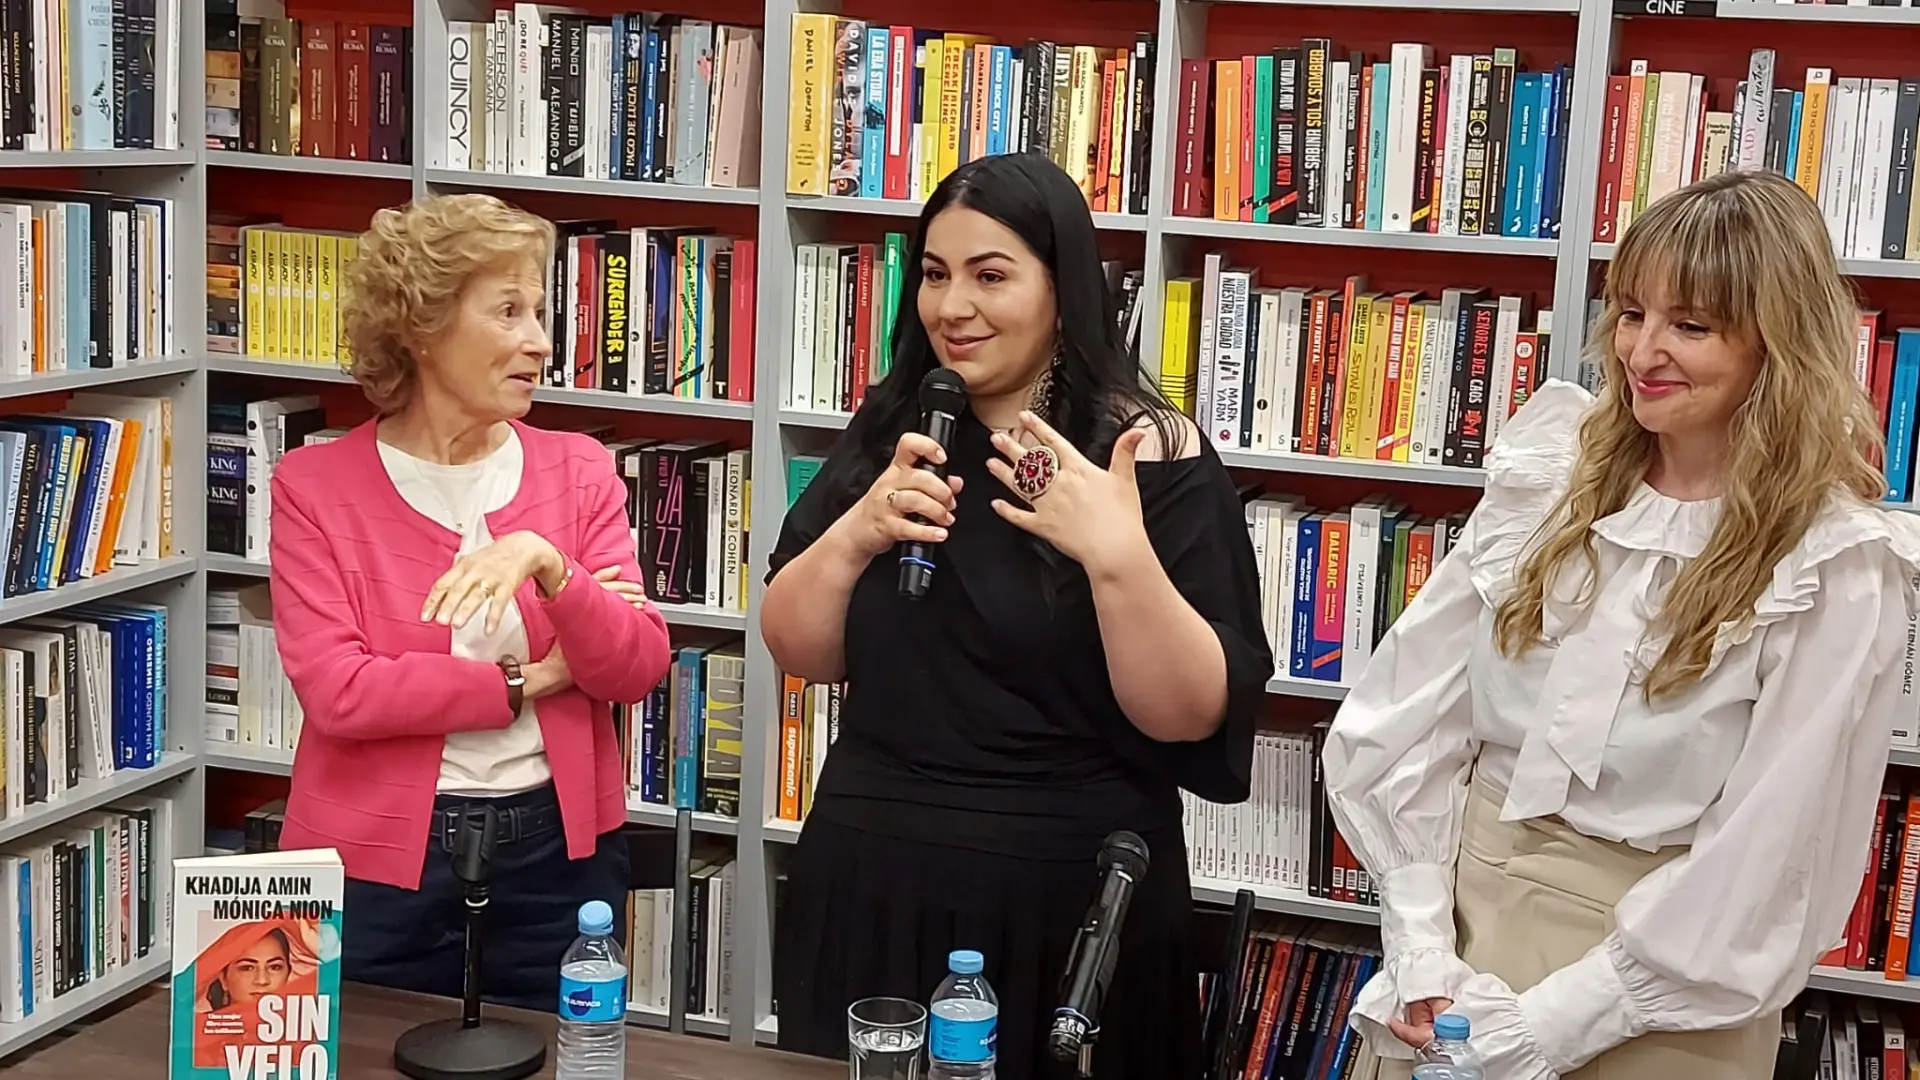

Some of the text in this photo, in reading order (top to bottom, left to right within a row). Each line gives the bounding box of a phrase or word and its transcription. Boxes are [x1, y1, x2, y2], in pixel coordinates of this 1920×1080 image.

[1645, 0, 1685, 15] CINE
[496, 20, 506, 112] PETERSON
[847, 29, 859, 83] DAVID
[943, 47, 952, 88] SCENE
[951, 47, 960, 88] FREAK
[1054, 52, 1070, 88] HEY!
[450, 38, 468, 149] QUINCY
[550, 19, 562, 158] MANUEL ALEJANDRO
[804, 29, 814, 131] DANIEL JOHNSTON
[993, 52, 1004, 133] FARGO ROCK CITY
[1812, 92, 1820, 108] CINE
[626, 86, 637, 166] PACO DE LUCÍA
[949, 95, 958, 150] RICHARD
[1304, 49, 1325, 169] SABINA SOL Y SOMBRA
[1421, 79, 1434, 145] STARLUST
[1630, 92, 1640, 131] MARIPOSAS
[1810, 119, 1817, 127] EN
[1811, 109, 1818, 118] EL
[832, 118, 842, 172] JONES
[1628, 132, 1635, 141] DE
[1743, 126, 1755, 160] LADY
[1806, 129, 1815, 163] CREACIÓN
[1626, 142, 1635, 177] CAZADOR
[1805, 164, 1812, 173] DE
[606, 254, 627, 353] SURRENDER
[1219, 277, 1234, 349] NUESTRA CIUDAD
[1457, 309, 1469, 348] SINATRA
[1455, 359, 1463, 372] YO
[1468, 310, 1491, 404] SEÑORES DEL CAOS
[1215, 389, 1226, 421] YARM
[1227, 388, 1238, 423] MARK
[210, 457, 237, 471] KING
[18, 491, 29, 530] ÁRBOL
[26, 443, 37, 470] VIDA
[46, 435, 71, 543] CÓMO DECIDE TU CEREBRO
[163, 464, 172, 534] GENES
[211, 486, 238, 500] KING
[729, 464, 738, 516] LEONARD
[727, 535, 737, 575] COHEN
[1326, 531, 1340, 589] BALEARIC
[1357, 563, 1365, 607] CONTRAPELO
[68, 636, 76, 672] WULF
[1903, 623, 1917, 695] FERNÁN GÓMEZ
[789, 692, 797, 716] oasis
[146, 734, 152, 750] UN
[785, 727, 796, 798] supersonic
[139, 820, 148, 873] Atapuerca
[185, 876, 312, 896] KHADIJA AMIN
[1894, 823, 1920, 938] ASÍ SE HACEN LAS PELÍCULAS
[213, 896, 333, 920] MÓNICA NION
[34, 939, 43, 976] DIOS
[257, 994, 331, 1043] SIN
[224, 1044, 329, 1080] VELO
